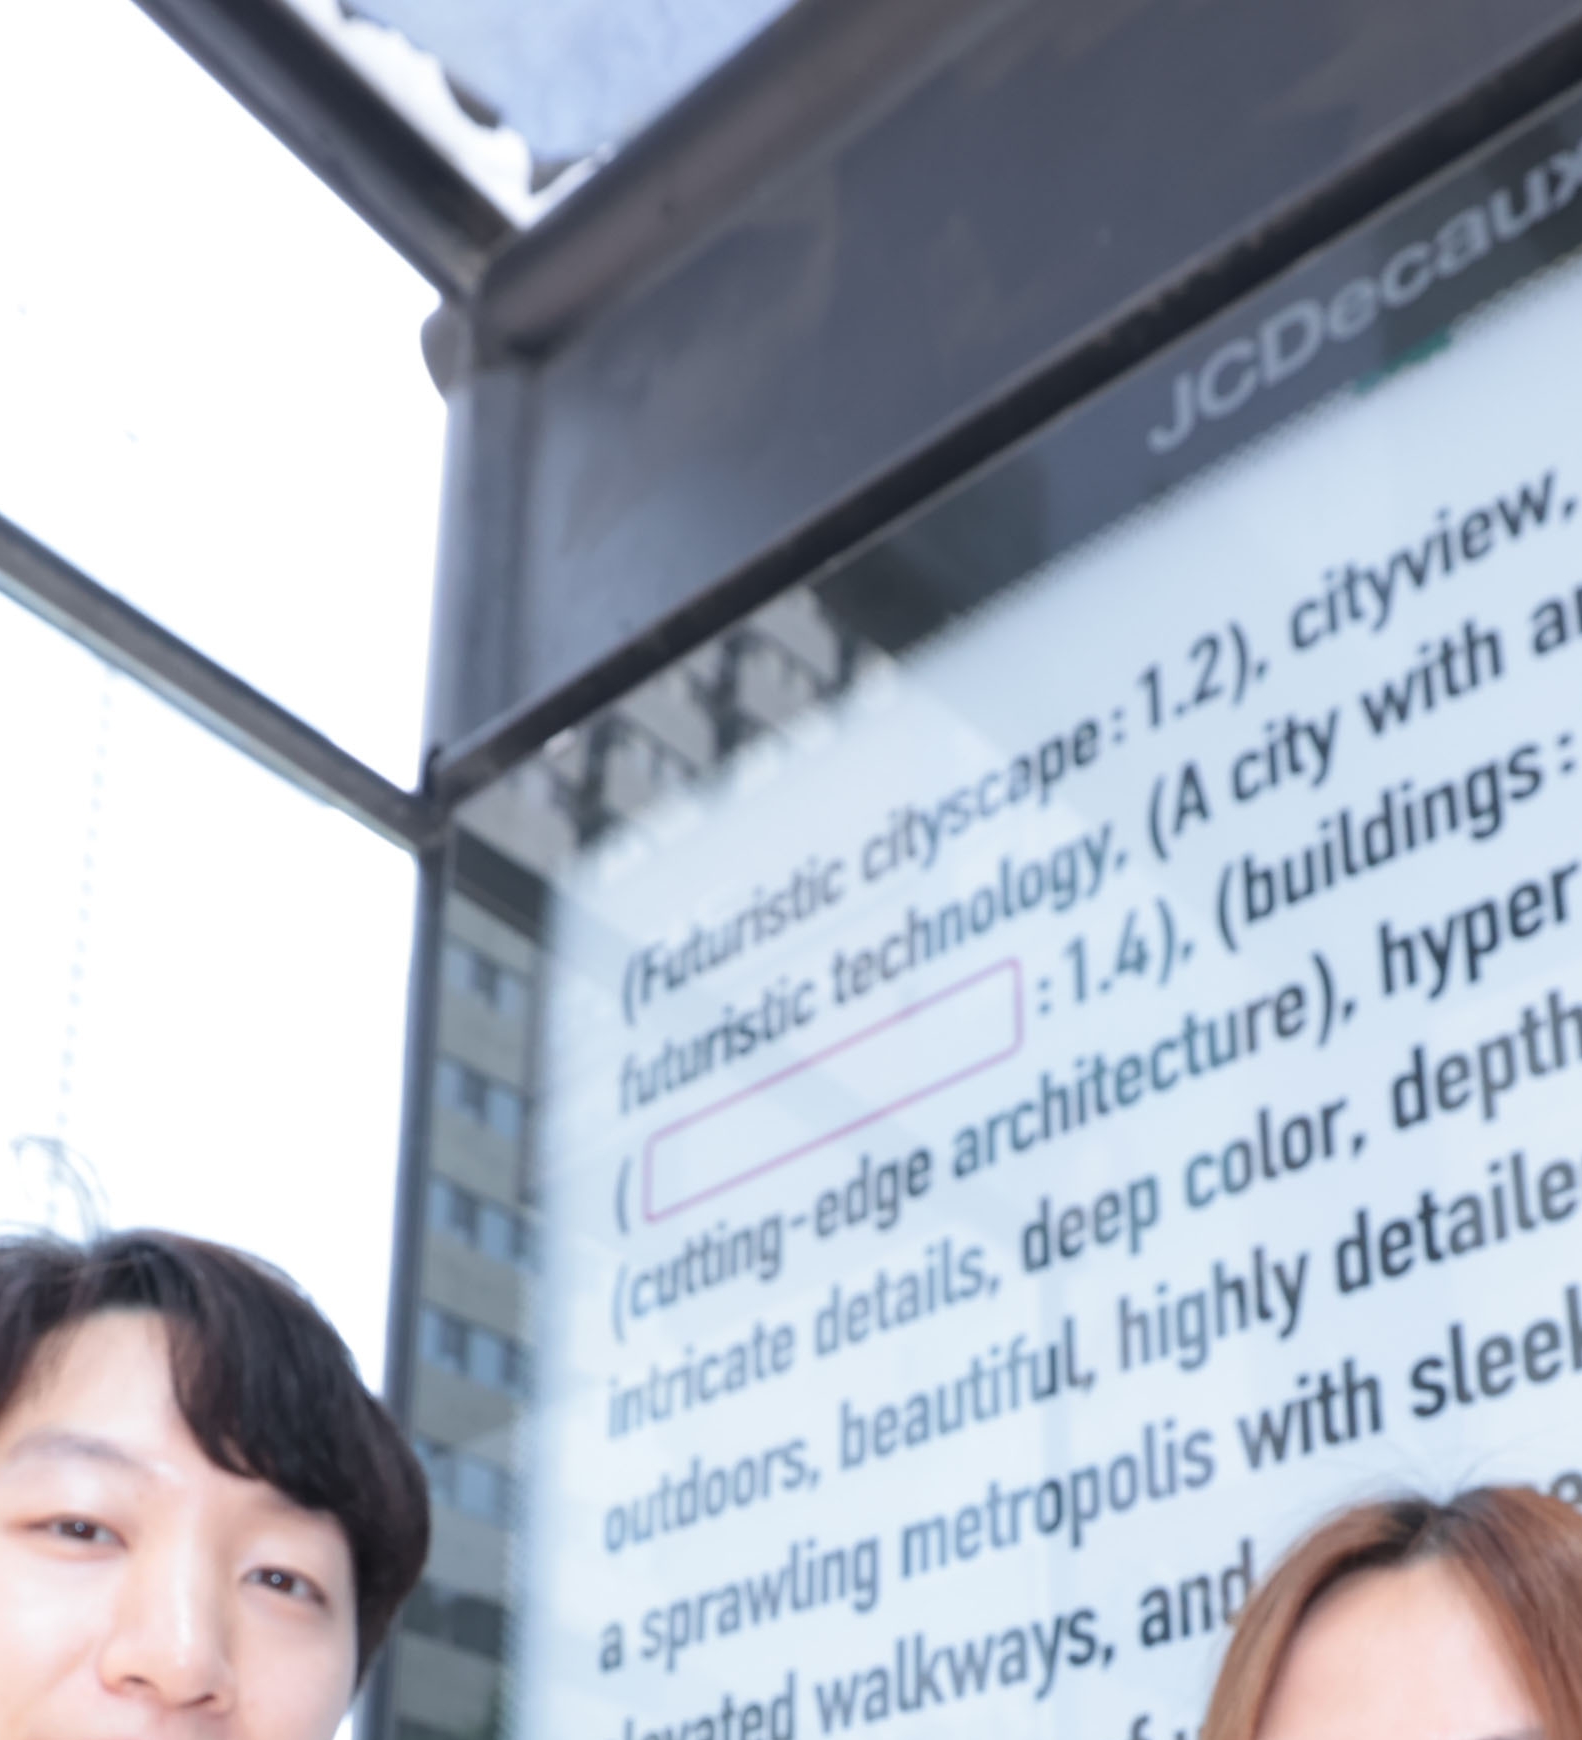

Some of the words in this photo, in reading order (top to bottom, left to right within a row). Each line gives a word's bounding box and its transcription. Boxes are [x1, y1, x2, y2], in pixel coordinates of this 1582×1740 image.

[619, 856, 846, 1026] (Futuristic
[1291, 470, 1578, 651] cityview,
[619, 974, 815, 1116] futuristic
[831, 822, 1126, 1004] technology,
[1149, 763, 1210, 860] (A
[1230, 706, 1339, 804] city
[1359, 617, 1504, 737] with
[608, 1321, 795, 1440] intricate
[815, 1238, 1001, 1357] details,
[1021, 1175, 1160, 1274] deep
[1184, 1095, 1367, 1212] color,
[612, 1152, 933, 1342] (cutting-edge
[951, 952, 1357, 1179] architecture),
[1378, 859, 1581, 999] hyper
[599, 1620, 622, 1675] a
[639, 1536, 881, 1674] sprawling
[900, 1419, 1216, 1582] metropolis
[1236, 1355, 1385, 1471] with
[603, 1436, 821, 1554] outdoors,
[839, 1315, 1096, 1471] beautiful,
[1117, 1244, 1308, 1372] highly
[815, 1606, 1116, 1737] walkways,
[1139, 1539, 1253, 1648] and
